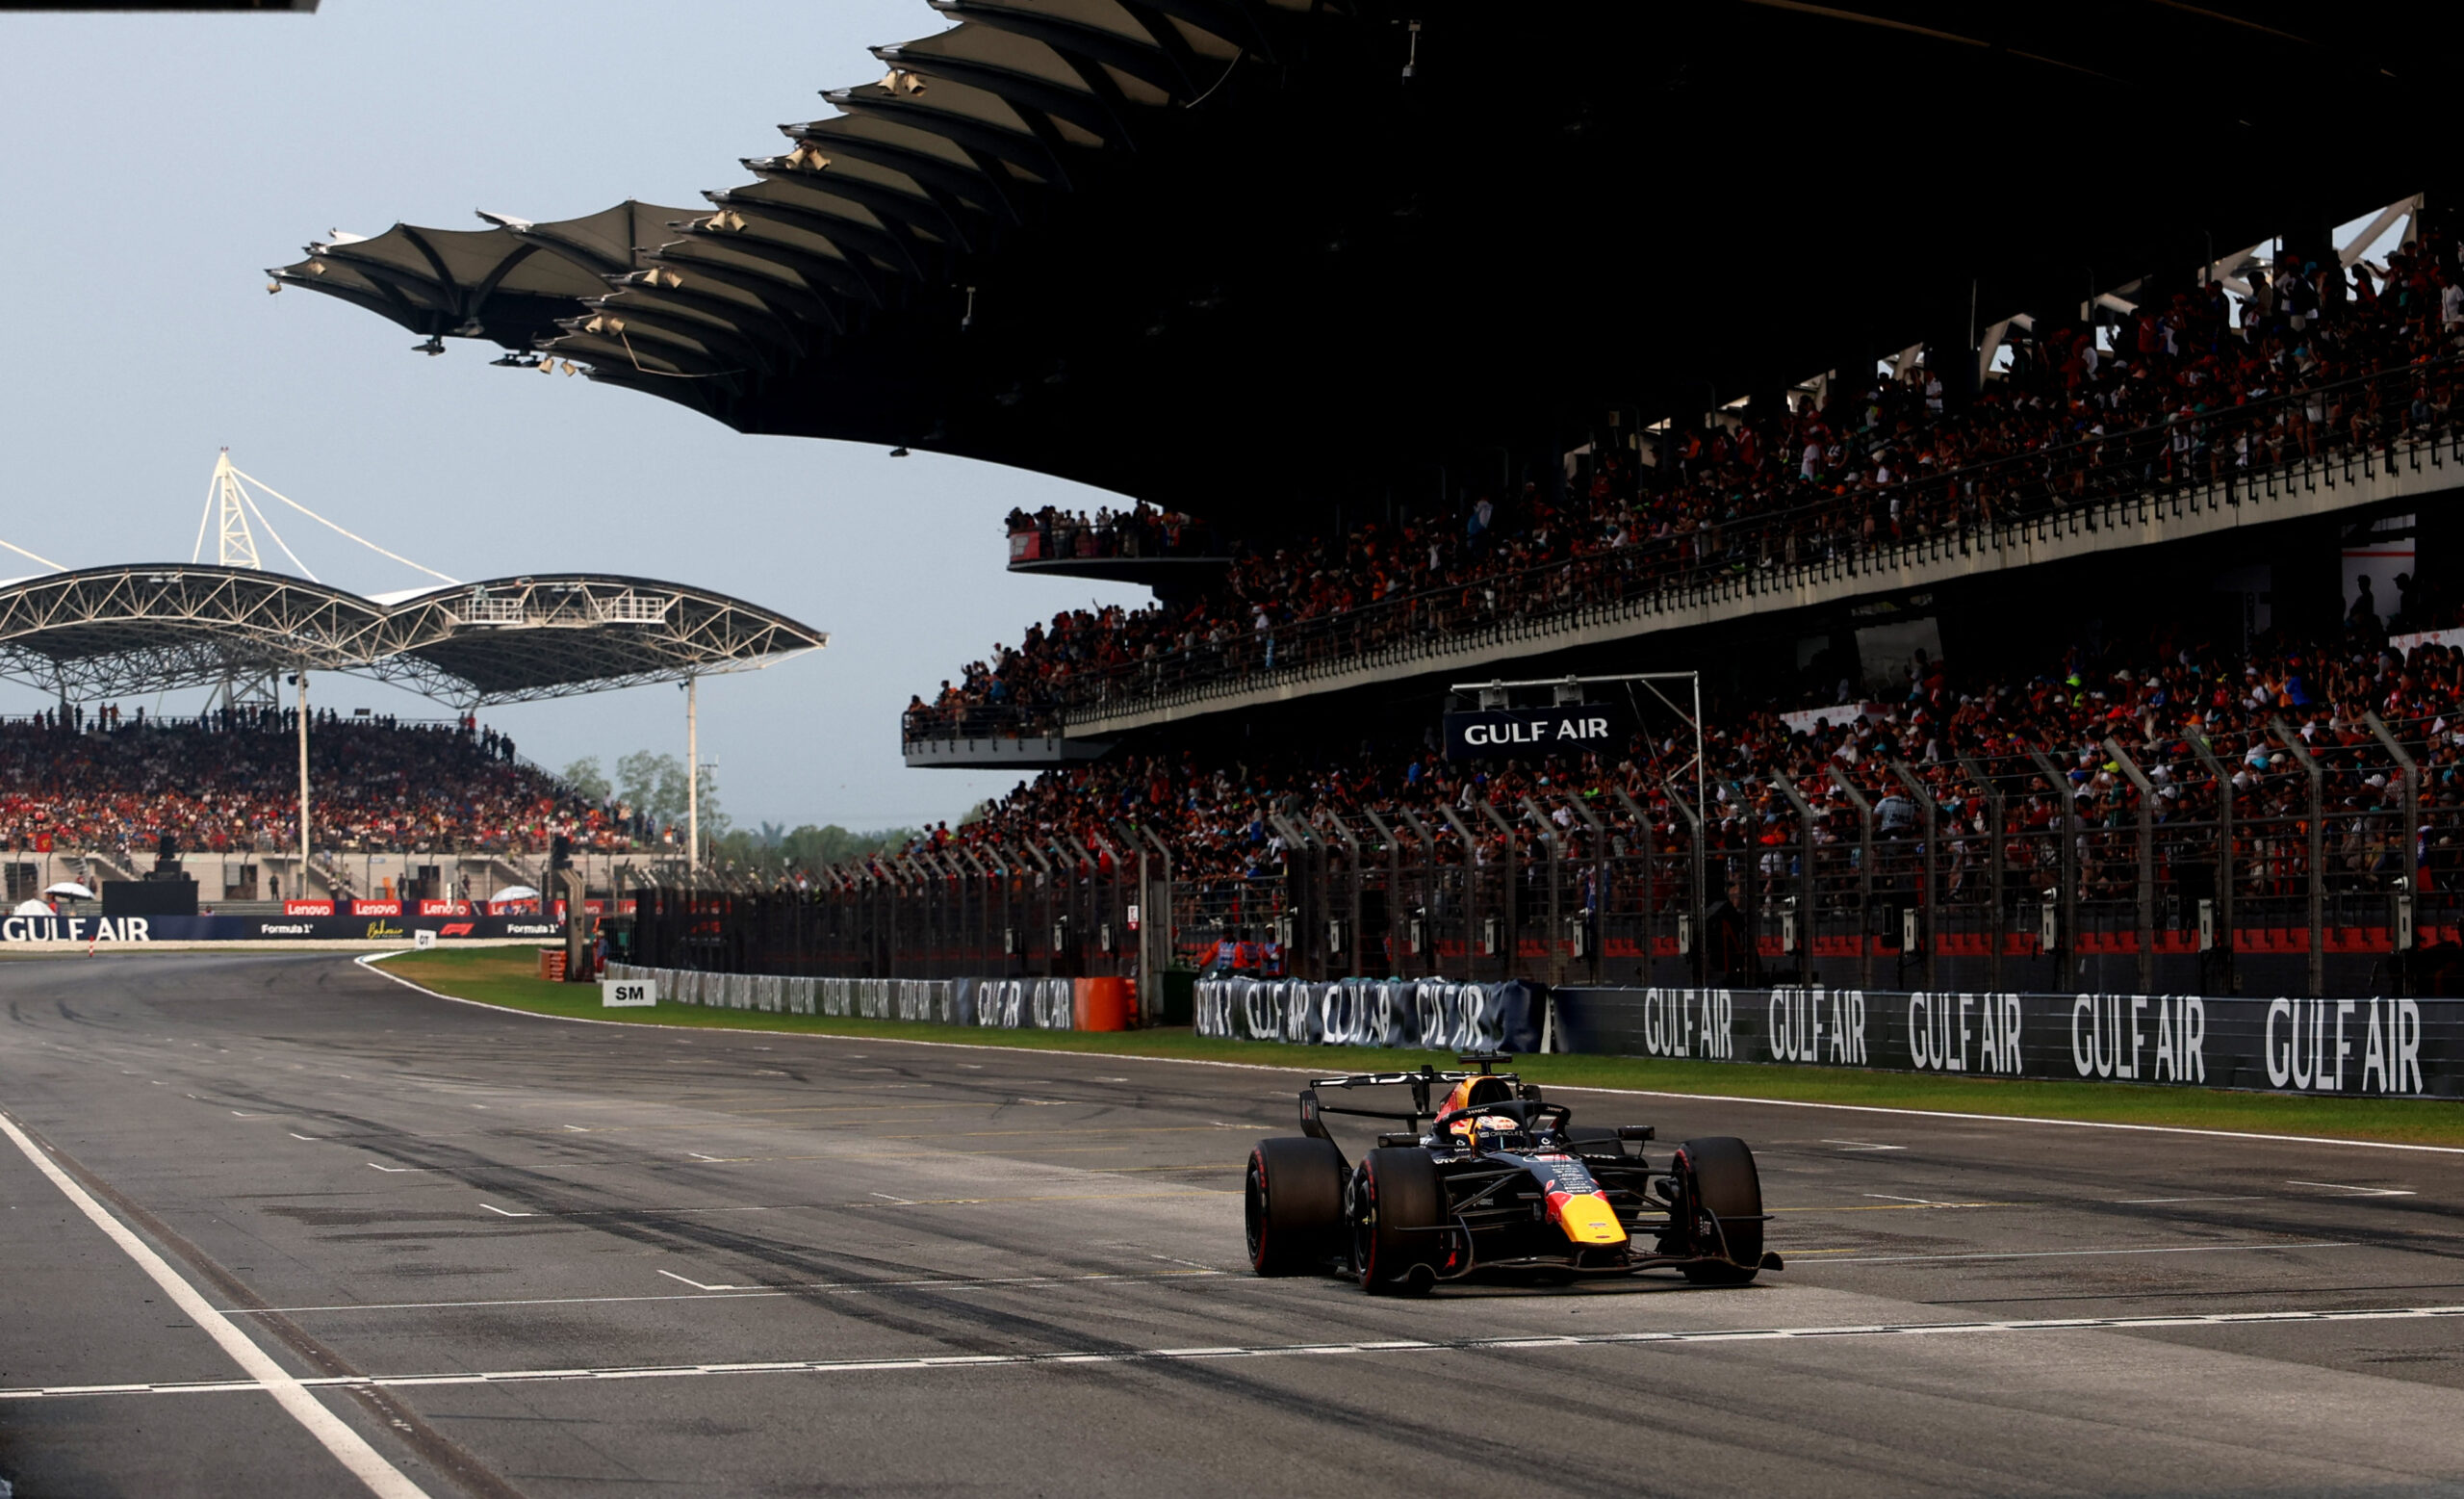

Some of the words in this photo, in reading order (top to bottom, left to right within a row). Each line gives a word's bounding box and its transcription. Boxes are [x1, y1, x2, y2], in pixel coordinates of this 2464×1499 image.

[1464, 721, 1548, 745] GULF
[1556, 717, 1609, 740] AIR
[288, 903, 331, 916] Lenovo
[355, 903, 398, 915] Lenovo
[424, 903, 467, 915] Lenoo
[2, 917, 87, 942] GULF
[95, 916, 151, 942] AIR
[261, 923, 303, 934] Formula
[507, 923, 549, 934] Formula
[615, 986, 644, 1001] SM
[1644, 987, 1695, 1057] GULF
[1700, 987, 1732, 1059] AIR
[1768, 989, 1825, 1062] GULF
[1830, 989, 1867, 1065] AIR
[1909, 992, 1974, 1072] GULF
[1980, 992, 2022, 1074] AIR
[2071, 994, 2147, 1079] GULF
[2154, 994, 2205, 1084] AIR
[2266, 996, 2355, 1091] GULF
[2362, 995, 2424, 1095] AIR
